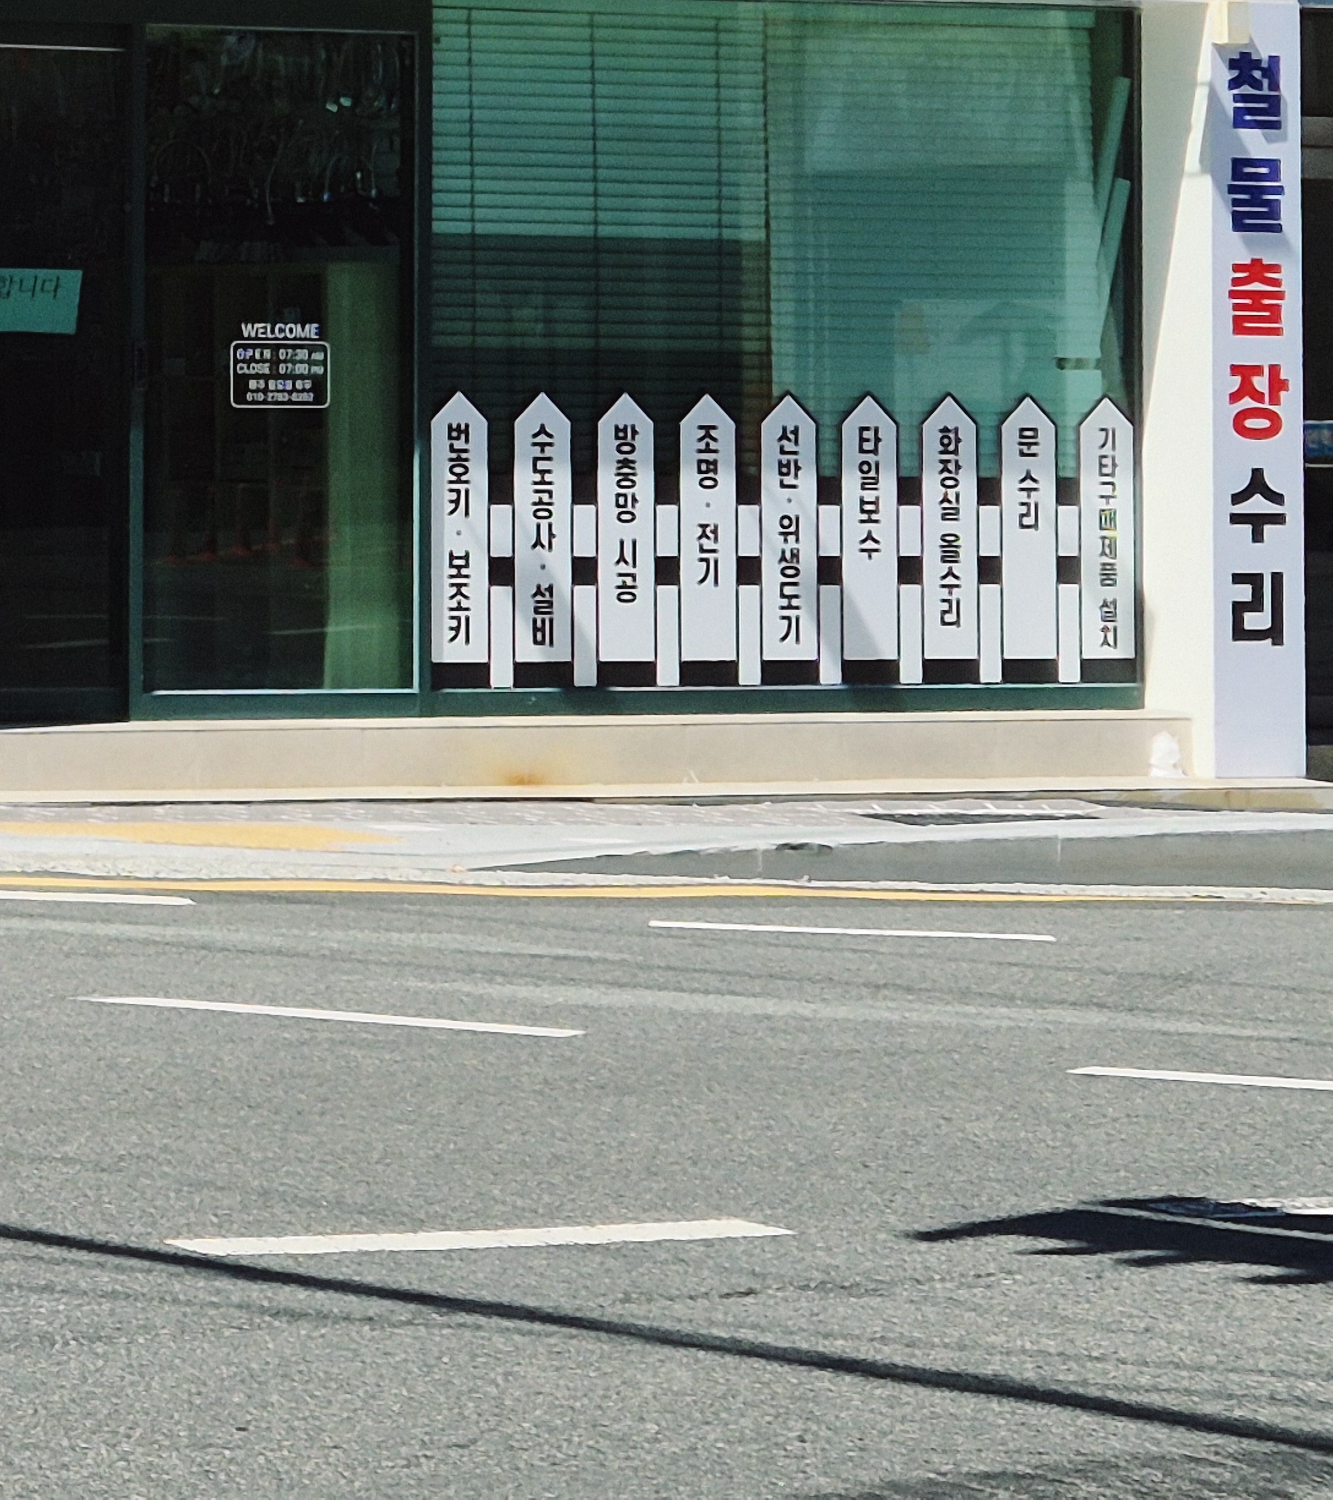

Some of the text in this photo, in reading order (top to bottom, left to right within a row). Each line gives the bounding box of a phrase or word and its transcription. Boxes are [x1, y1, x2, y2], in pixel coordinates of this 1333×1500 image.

[236, 363, 271, 374] CLOSE
[241, 322, 320, 339] WELCOME
[446, 422, 471, 646] 번호키 보조키
[530, 422, 557, 648] 수도공사 설비
[613, 423, 639, 604] 방충망 시공
[695, 424, 720, 588] 조명 전기
[776, 425, 802, 645] 선반 위생도기
[857, 425, 882, 561] 타일보수
[937, 425, 963, 629] 화장실 올수리
[1017, 426, 1041, 532] 문 수리
[1098, 597, 1119, 651] 설치
